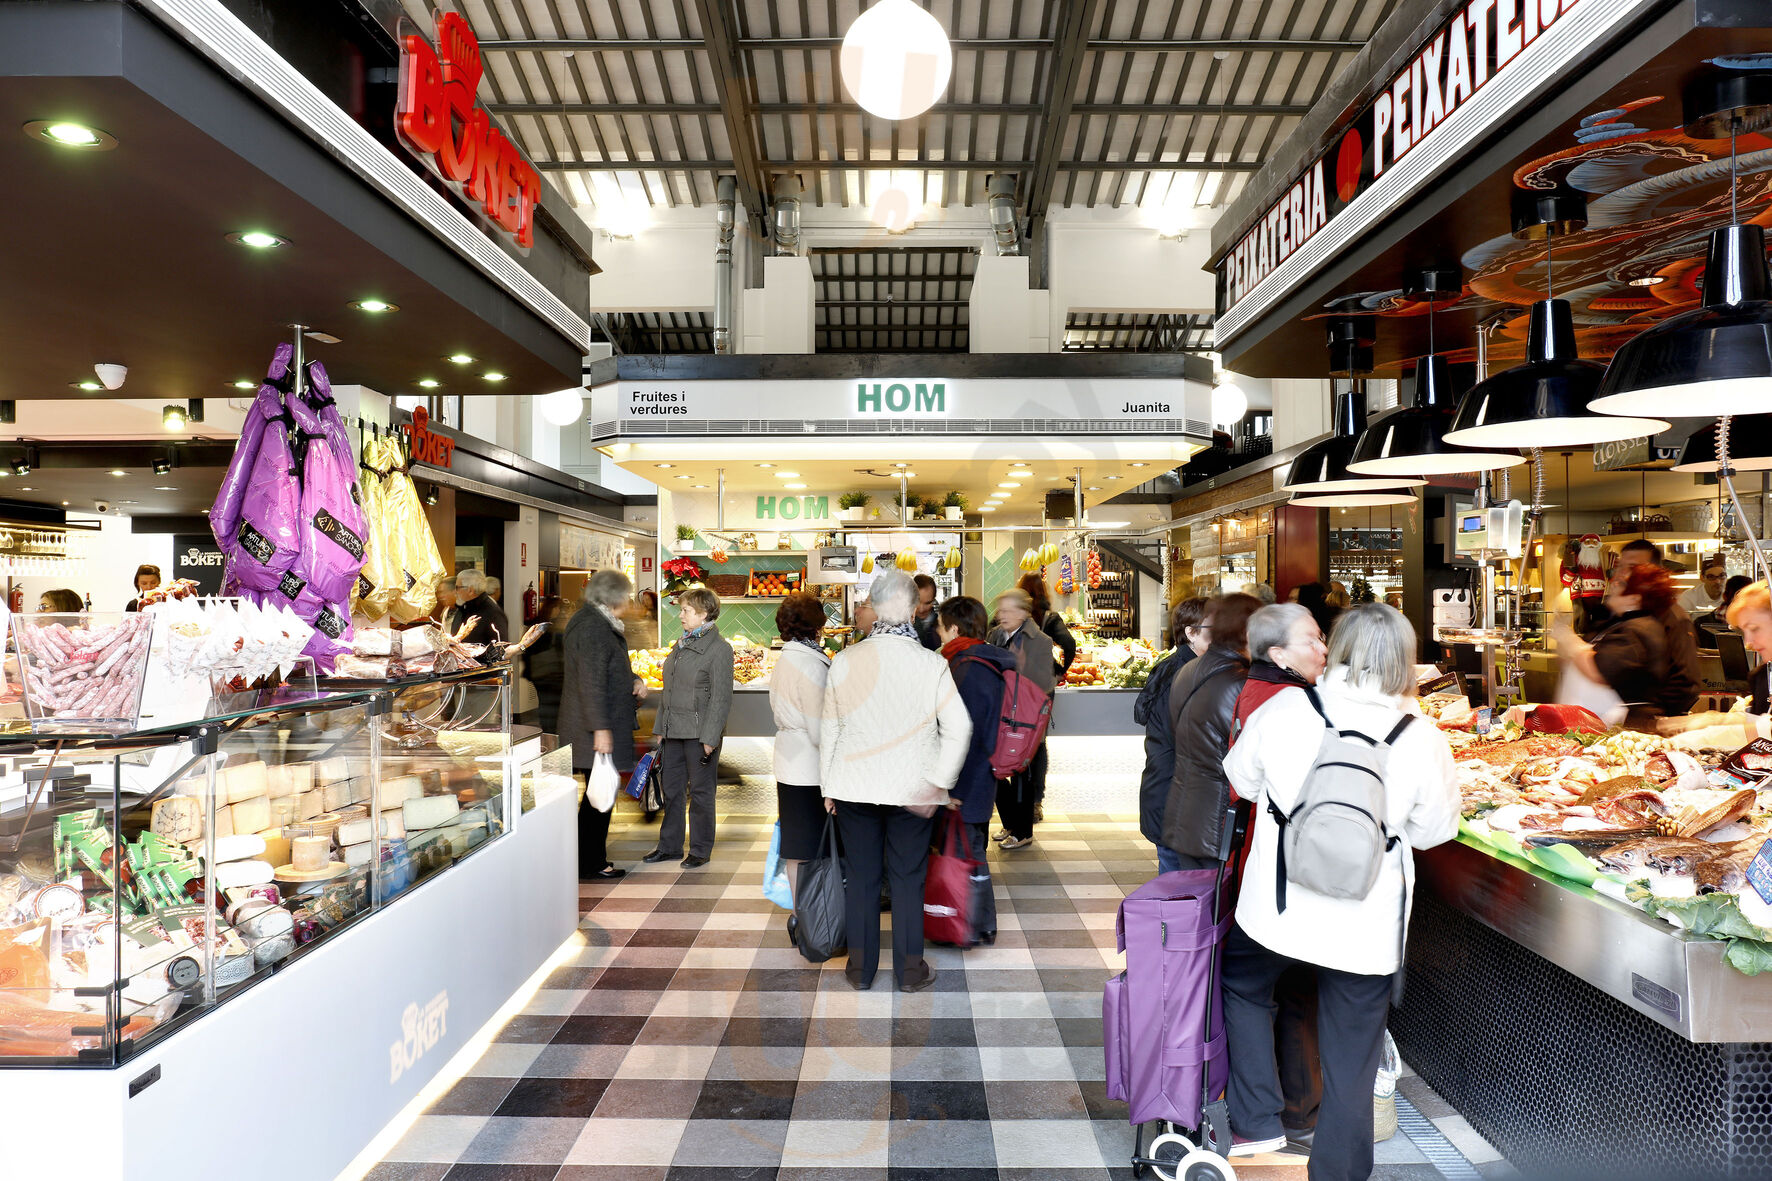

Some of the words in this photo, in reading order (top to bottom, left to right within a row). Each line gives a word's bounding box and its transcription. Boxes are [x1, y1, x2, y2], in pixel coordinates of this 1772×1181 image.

[397, 33, 541, 248] BOKET
[1226, 158, 1326, 311] PEIXATERIA
[632, 391, 677, 402] Fruites
[681, 390, 686, 402] i
[858, 383, 945, 412] HOM
[630, 404, 687, 414] verdures
[1122, 402, 1170, 413] Juanita
[757, 496, 828, 519] HOM
[247, 532, 270, 553] ARTURO
[338, 529, 362, 550] ARTURO
[180, 555, 223, 566] BOKET
[390, 997, 448, 1085] BOKET
